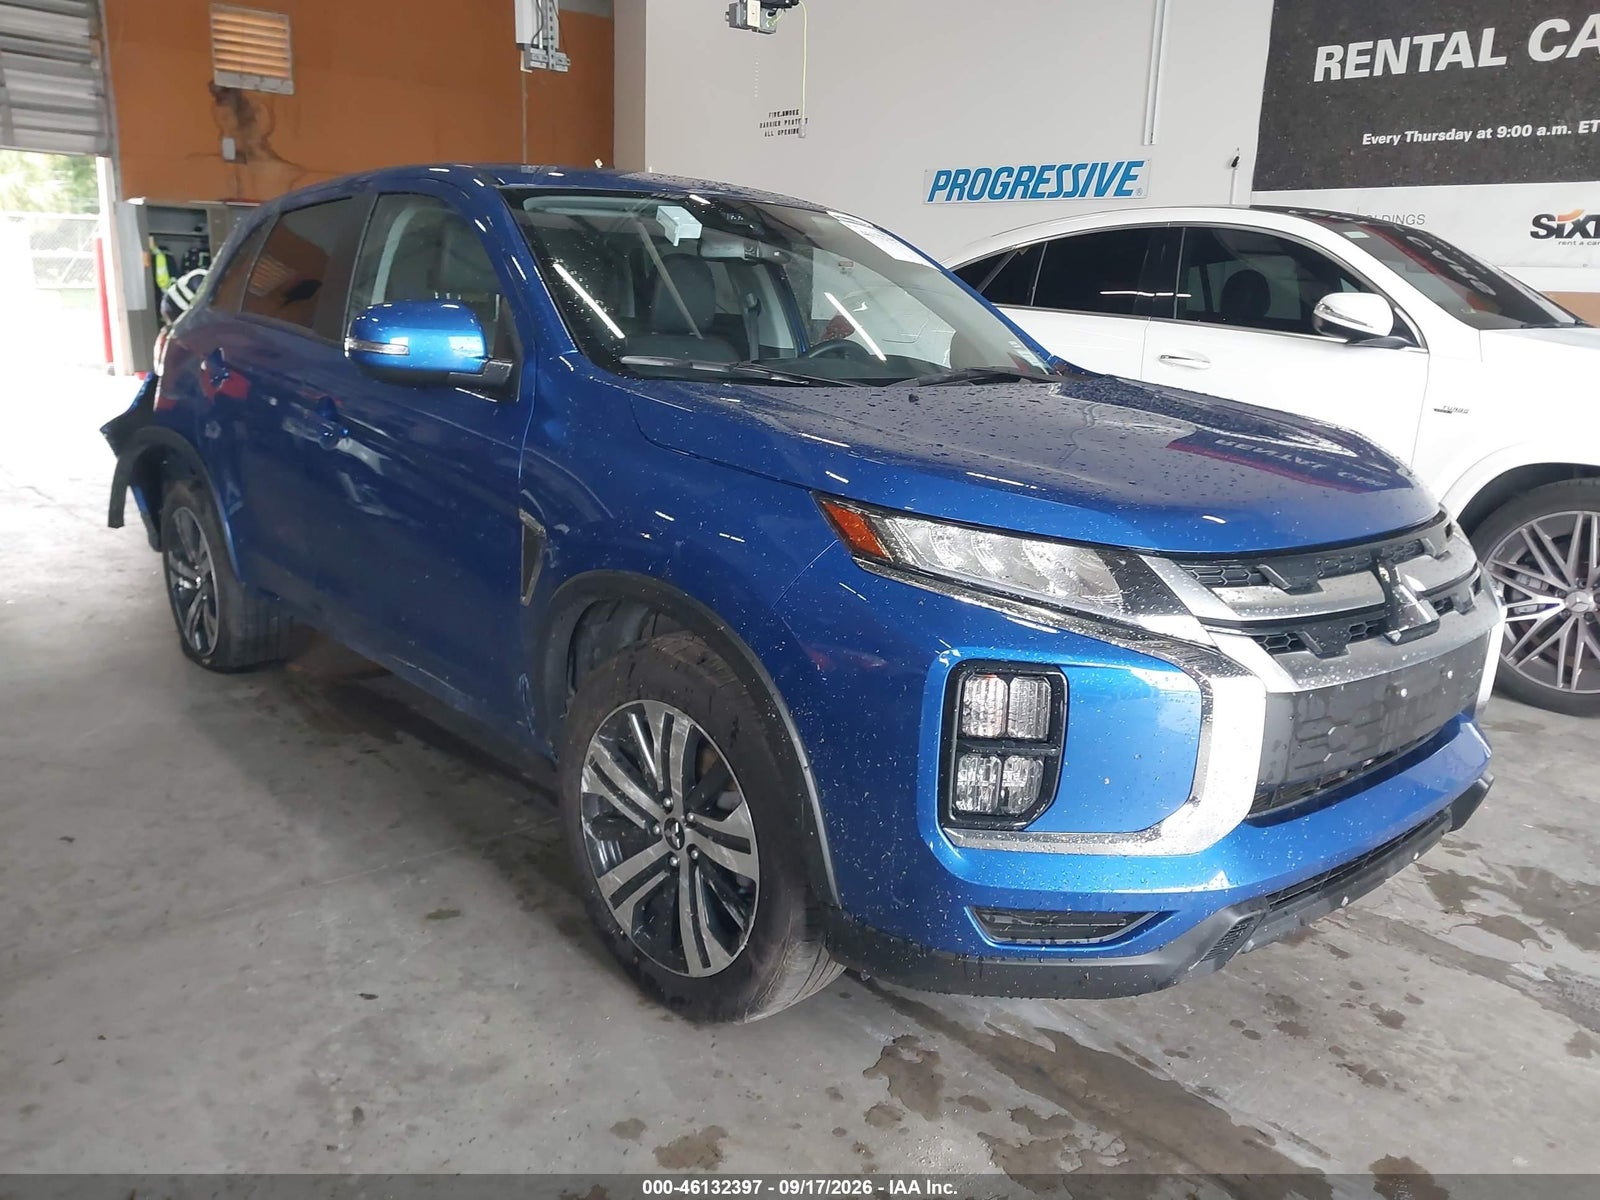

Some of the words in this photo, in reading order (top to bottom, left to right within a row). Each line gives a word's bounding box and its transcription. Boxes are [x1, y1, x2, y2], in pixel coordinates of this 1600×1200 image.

[1313, 27, 1507, 82] RENTAL
[1527, 13, 1600, 62] CA
[1362, 133, 1401, 146] Every
[1404, 128, 1473, 142] Thursday
[1476, 127, 1493, 139] at
[1496, 124, 1533, 138] 9:00
[1536, 126, 1572, 136] a.m.
[1578, 119, 1600, 133] ET
[927, 160, 1145, 202] PROGRESSIVE
